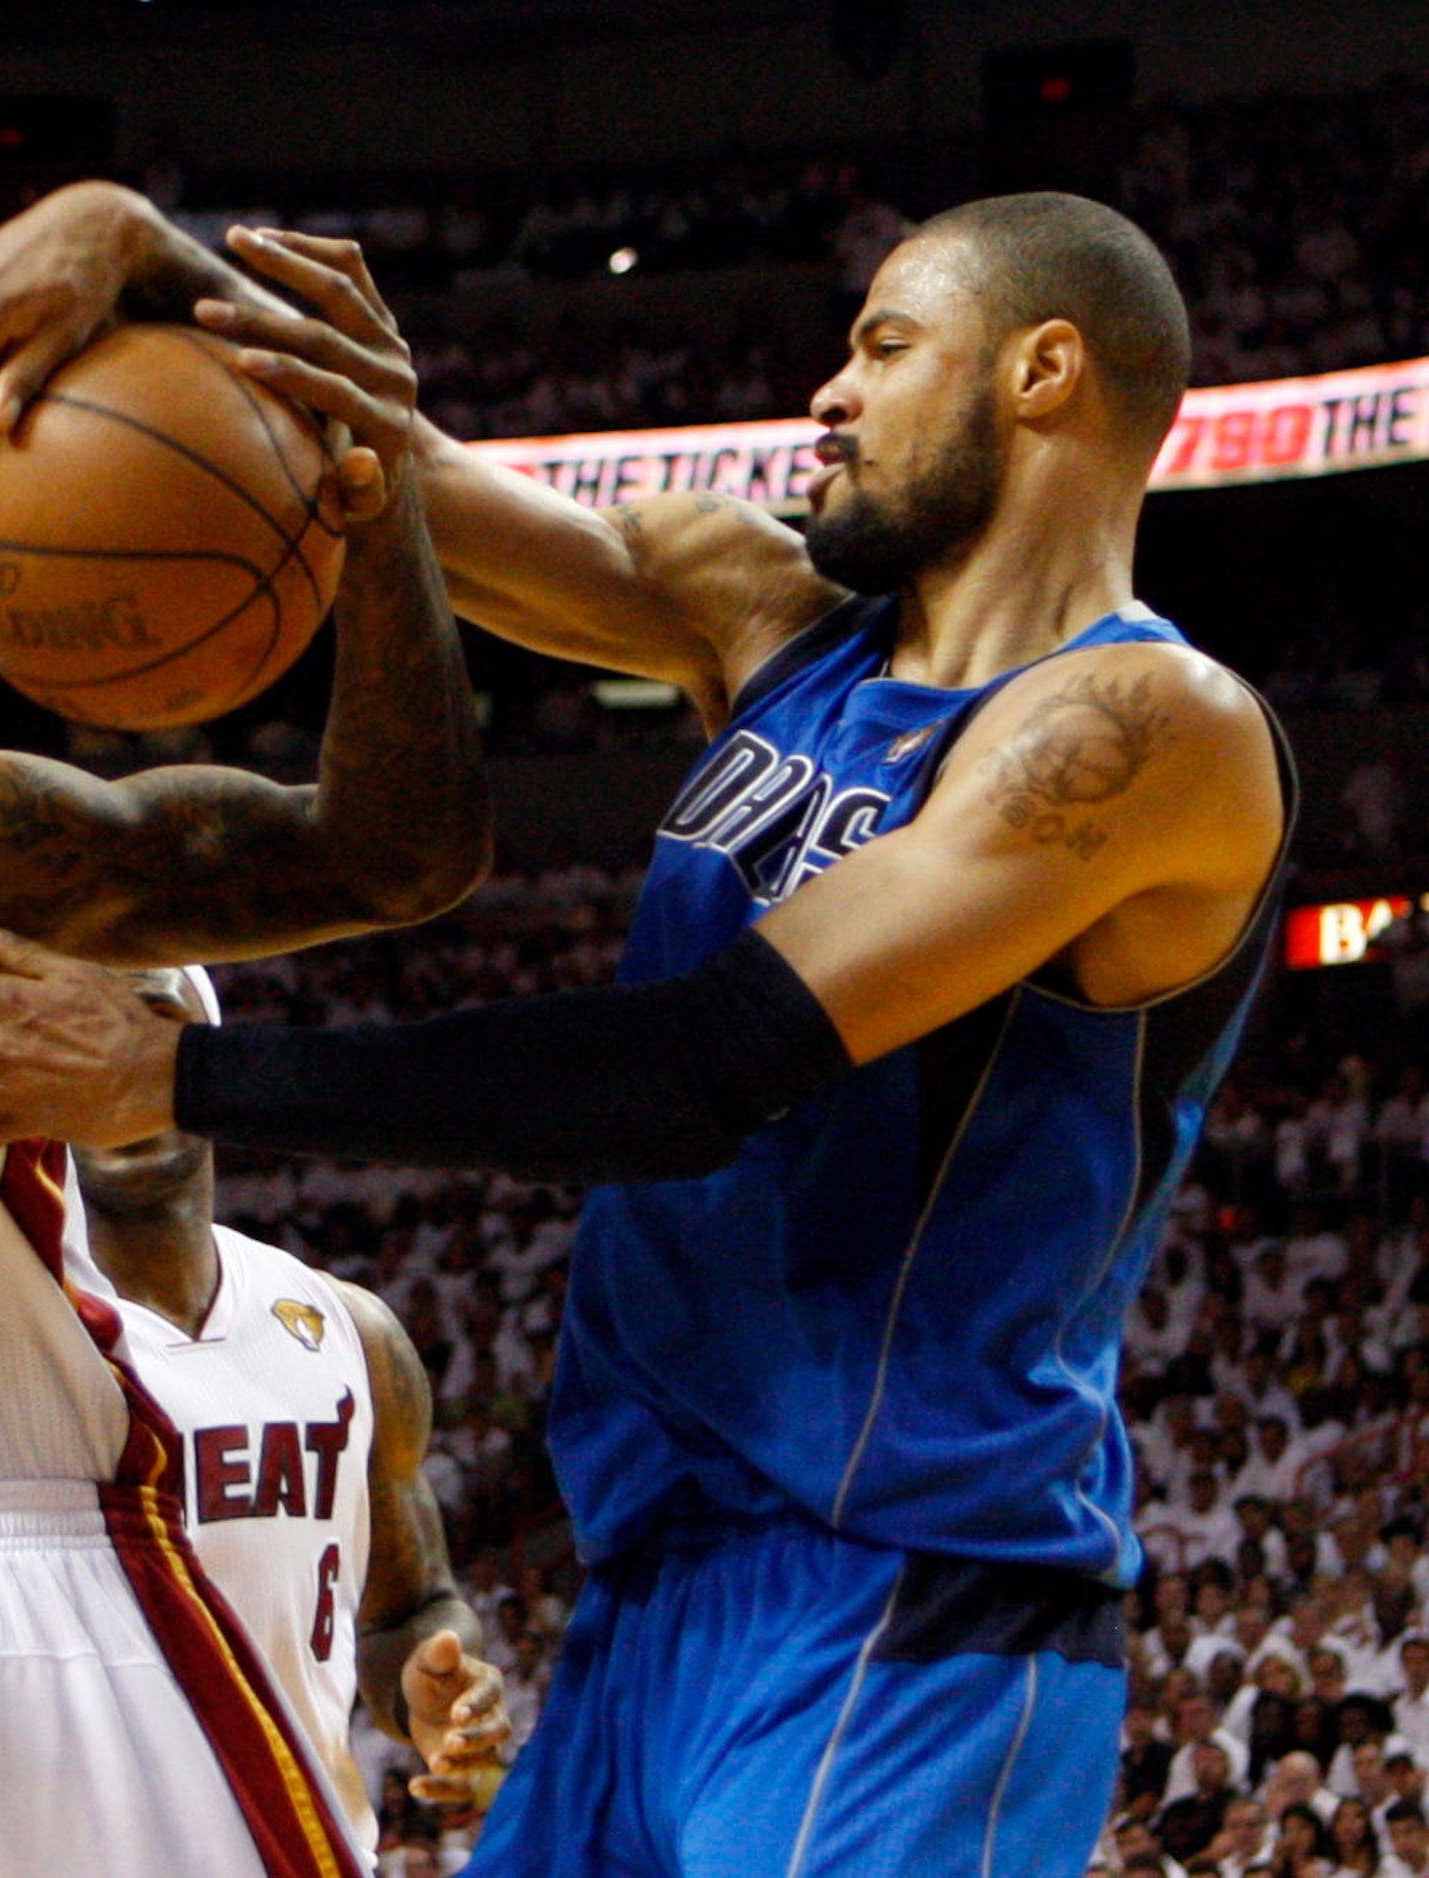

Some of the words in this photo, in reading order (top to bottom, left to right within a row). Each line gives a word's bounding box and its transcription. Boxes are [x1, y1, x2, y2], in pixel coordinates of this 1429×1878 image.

[540, 455, 646, 508] THE
[1166, 404, 1313, 474] 790
[1321, 387, 1419, 457] THE
[180, 1385, 355, 1530] EAT
[310, 1543, 340, 1662] 6
